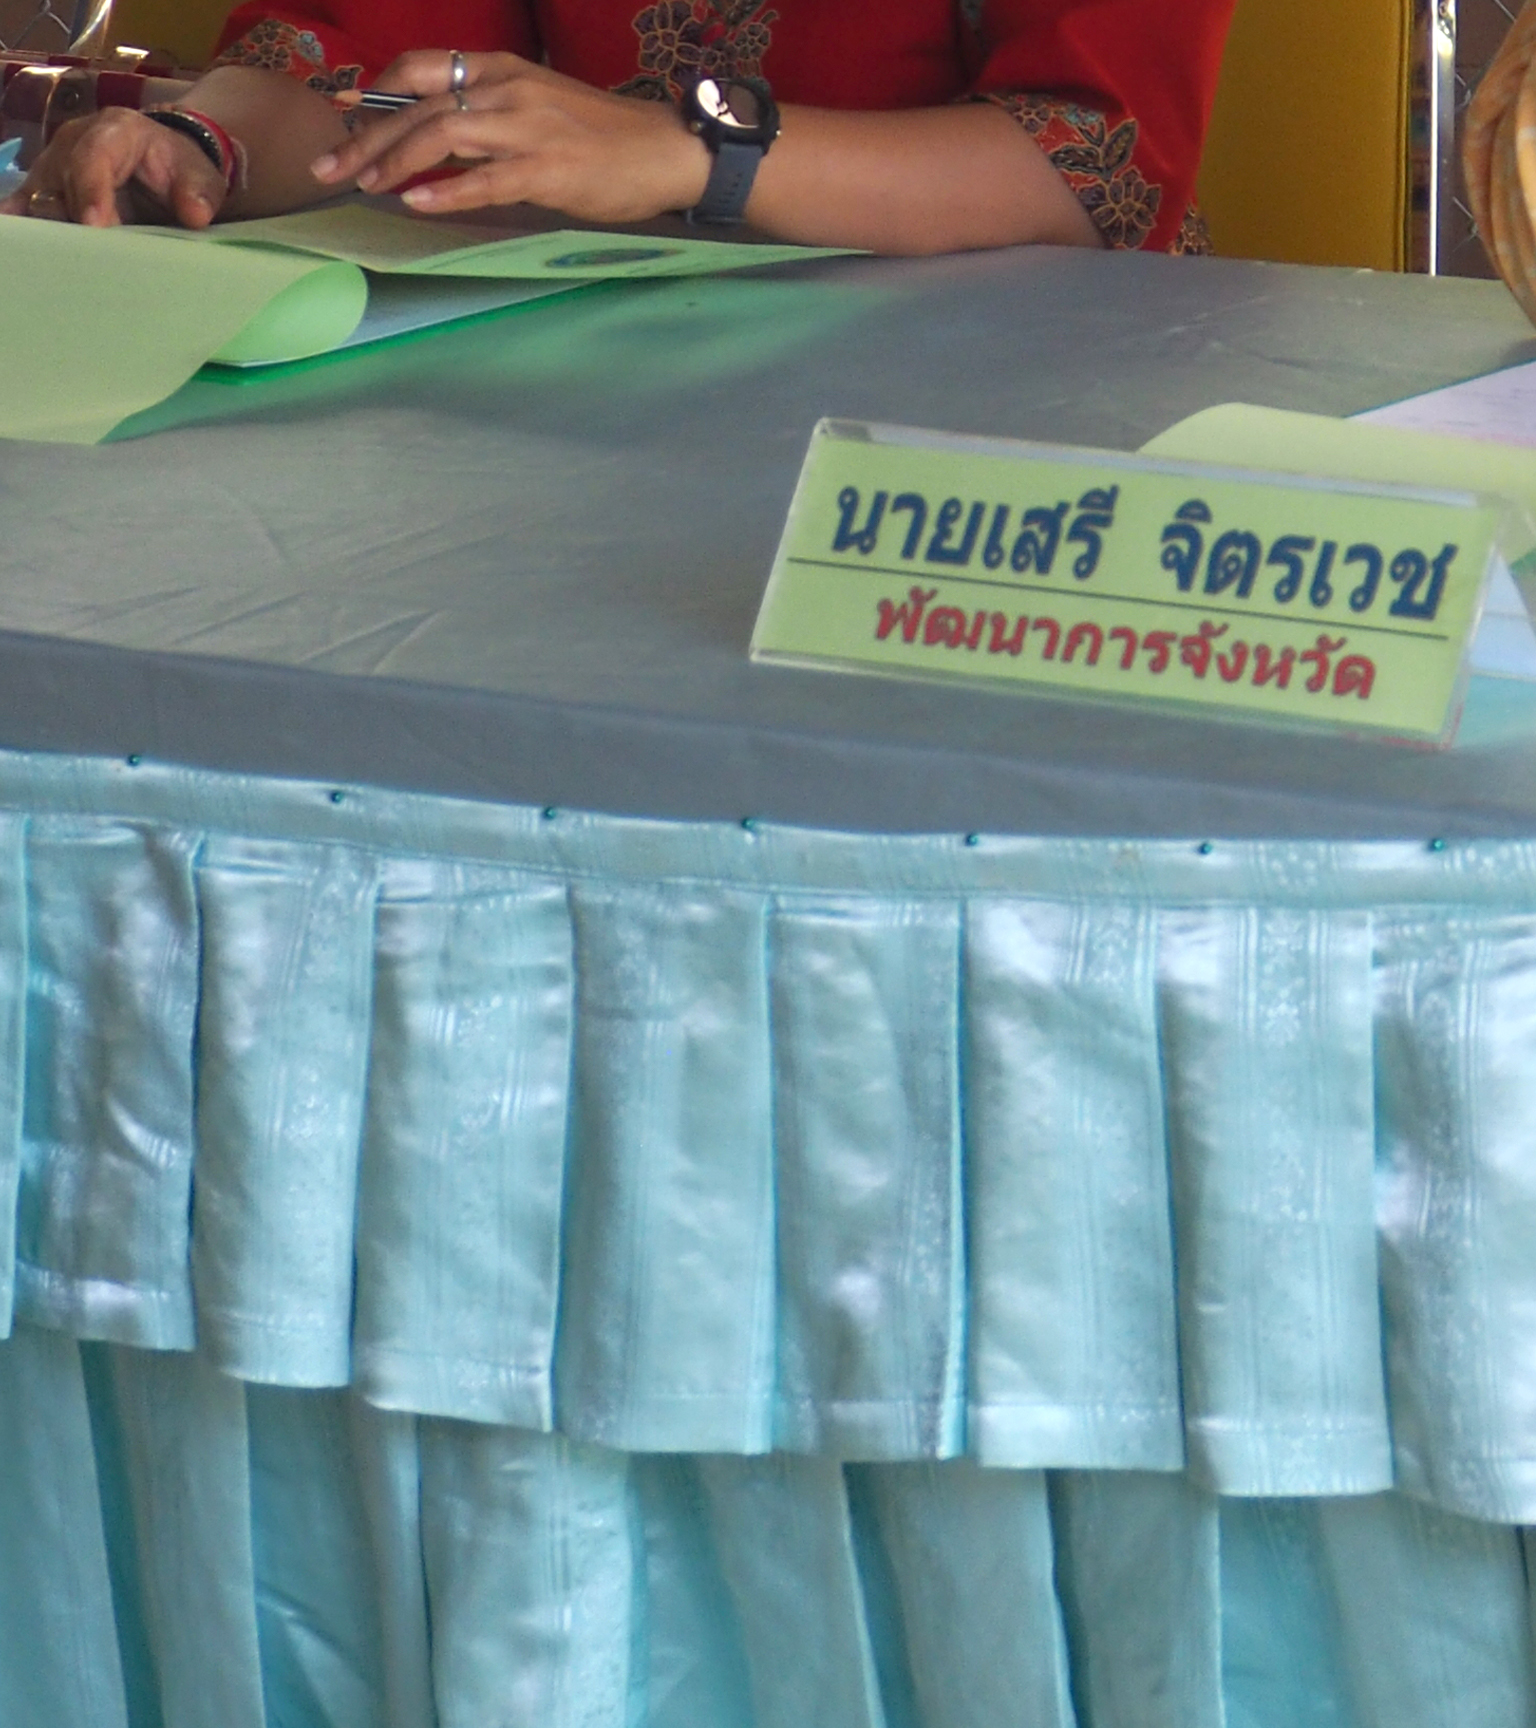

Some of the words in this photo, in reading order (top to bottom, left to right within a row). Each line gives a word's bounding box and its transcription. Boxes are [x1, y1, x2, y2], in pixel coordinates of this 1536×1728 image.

[831, 484, 1120, 581] นายเสรี
[1159, 498, 1458, 621] จิตรเวช
[875, 587, 1376, 700] พัฒนาการจังหวัด
